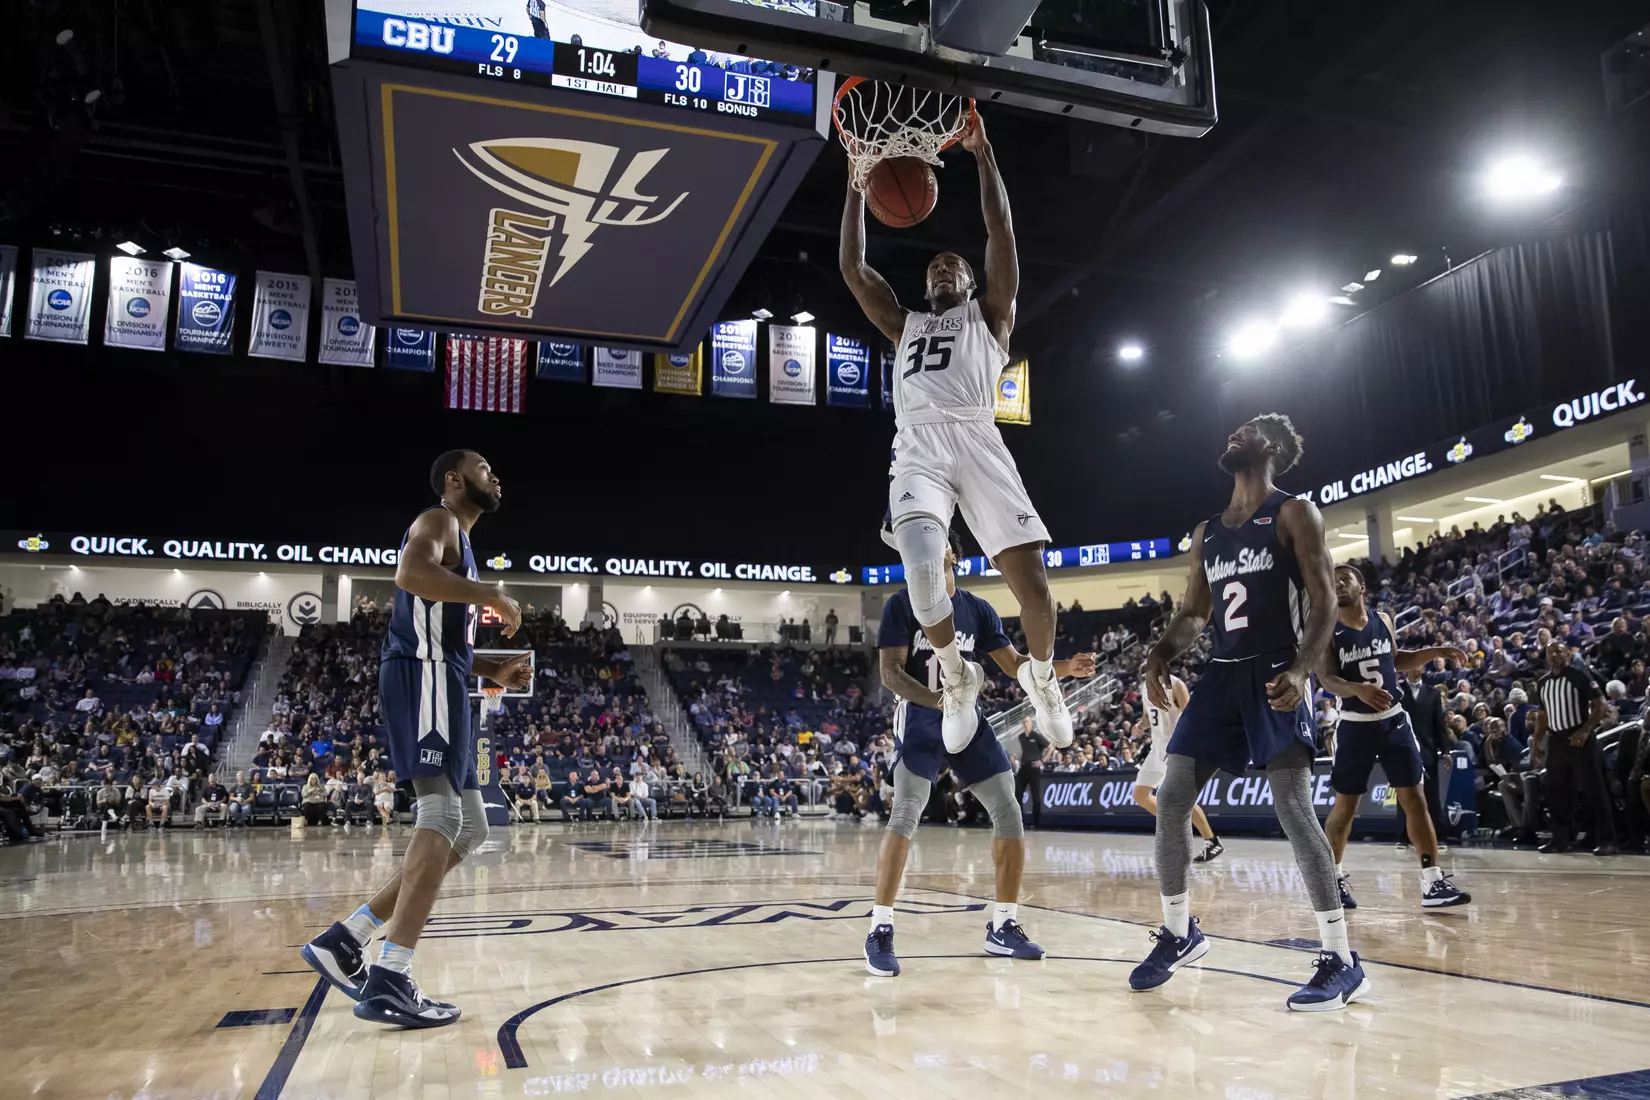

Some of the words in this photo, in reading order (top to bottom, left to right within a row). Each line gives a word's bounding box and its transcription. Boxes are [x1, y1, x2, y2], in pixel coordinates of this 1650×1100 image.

[383, 18, 456, 54] CBU
[490, 34, 518, 63] 29
[478, 63, 503, 77] FLS
[514, 69, 521, 79] 8
[578, 49, 616, 77] 1:04
[567, 78, 588, 89] 1ST
[597, 82, 628, 95] HALF
[675, 65, 701, 92] 30
[664, 93, 687, 106] FLS
[693, 98, 707, 109] 10
[717, 101, 758, 117] BONUS
[46, 258, 80, 269] 2017
[478, 208, 556, 319] LANCERS
[47, 270, 75, 278] MEN'S
[126, 267, 158, 278] 2016
[192, 271, 226, 284] 2016
[33, 277, 86, 288] BASKETBAL
[194, 283, 221, 292] MEN'S
[267, 279, 298, 291] 2015
[335, 288, 356, 296] 201
[38, 313, 72, 322] DIVISION
[117, 321, 150, 329] DIVISION
[109, 326, 163, 338] TOURNAMENT
[257, 331, 294, 340] DIVISION
[719, 324, 743, 335] 201
[903, 336, 955, 380] 35
[712, 376, 754, 384] CHAMPIONS
[1553, 379, 1646, 427] QUICK.
[1320, 480, 1348, 504] OIL
[1351, 452, 1433, 494] CHANGE.
[70, 536, 154, 555] QUICK.
[163, 540, 268, 560] QUALITY.
[277, 544, 313, 562] OIL
[957, 559, 971, 576] 29
[1047, 550, 1062, 568] 30
[1237, 547, 1274, 574] State
[529, 555, 598, 573] QUICK.
[605, 558, 693, 576] QUALITY.
[700, 562, 731, 578] OIL
[735, 564, 817, 581] CHANGE.
[482, 606, 503, 624] 24
[1222, 581, 1248, 632] 2
[1339, 644, 1371, 670] Jackson
[1358, 658, 1384, 689] 5
[476, 737, 490, 786] CBU
[1043, 783, 1093, 809] QUICK.
[1226, 774, 1335, 805] CHAE.
